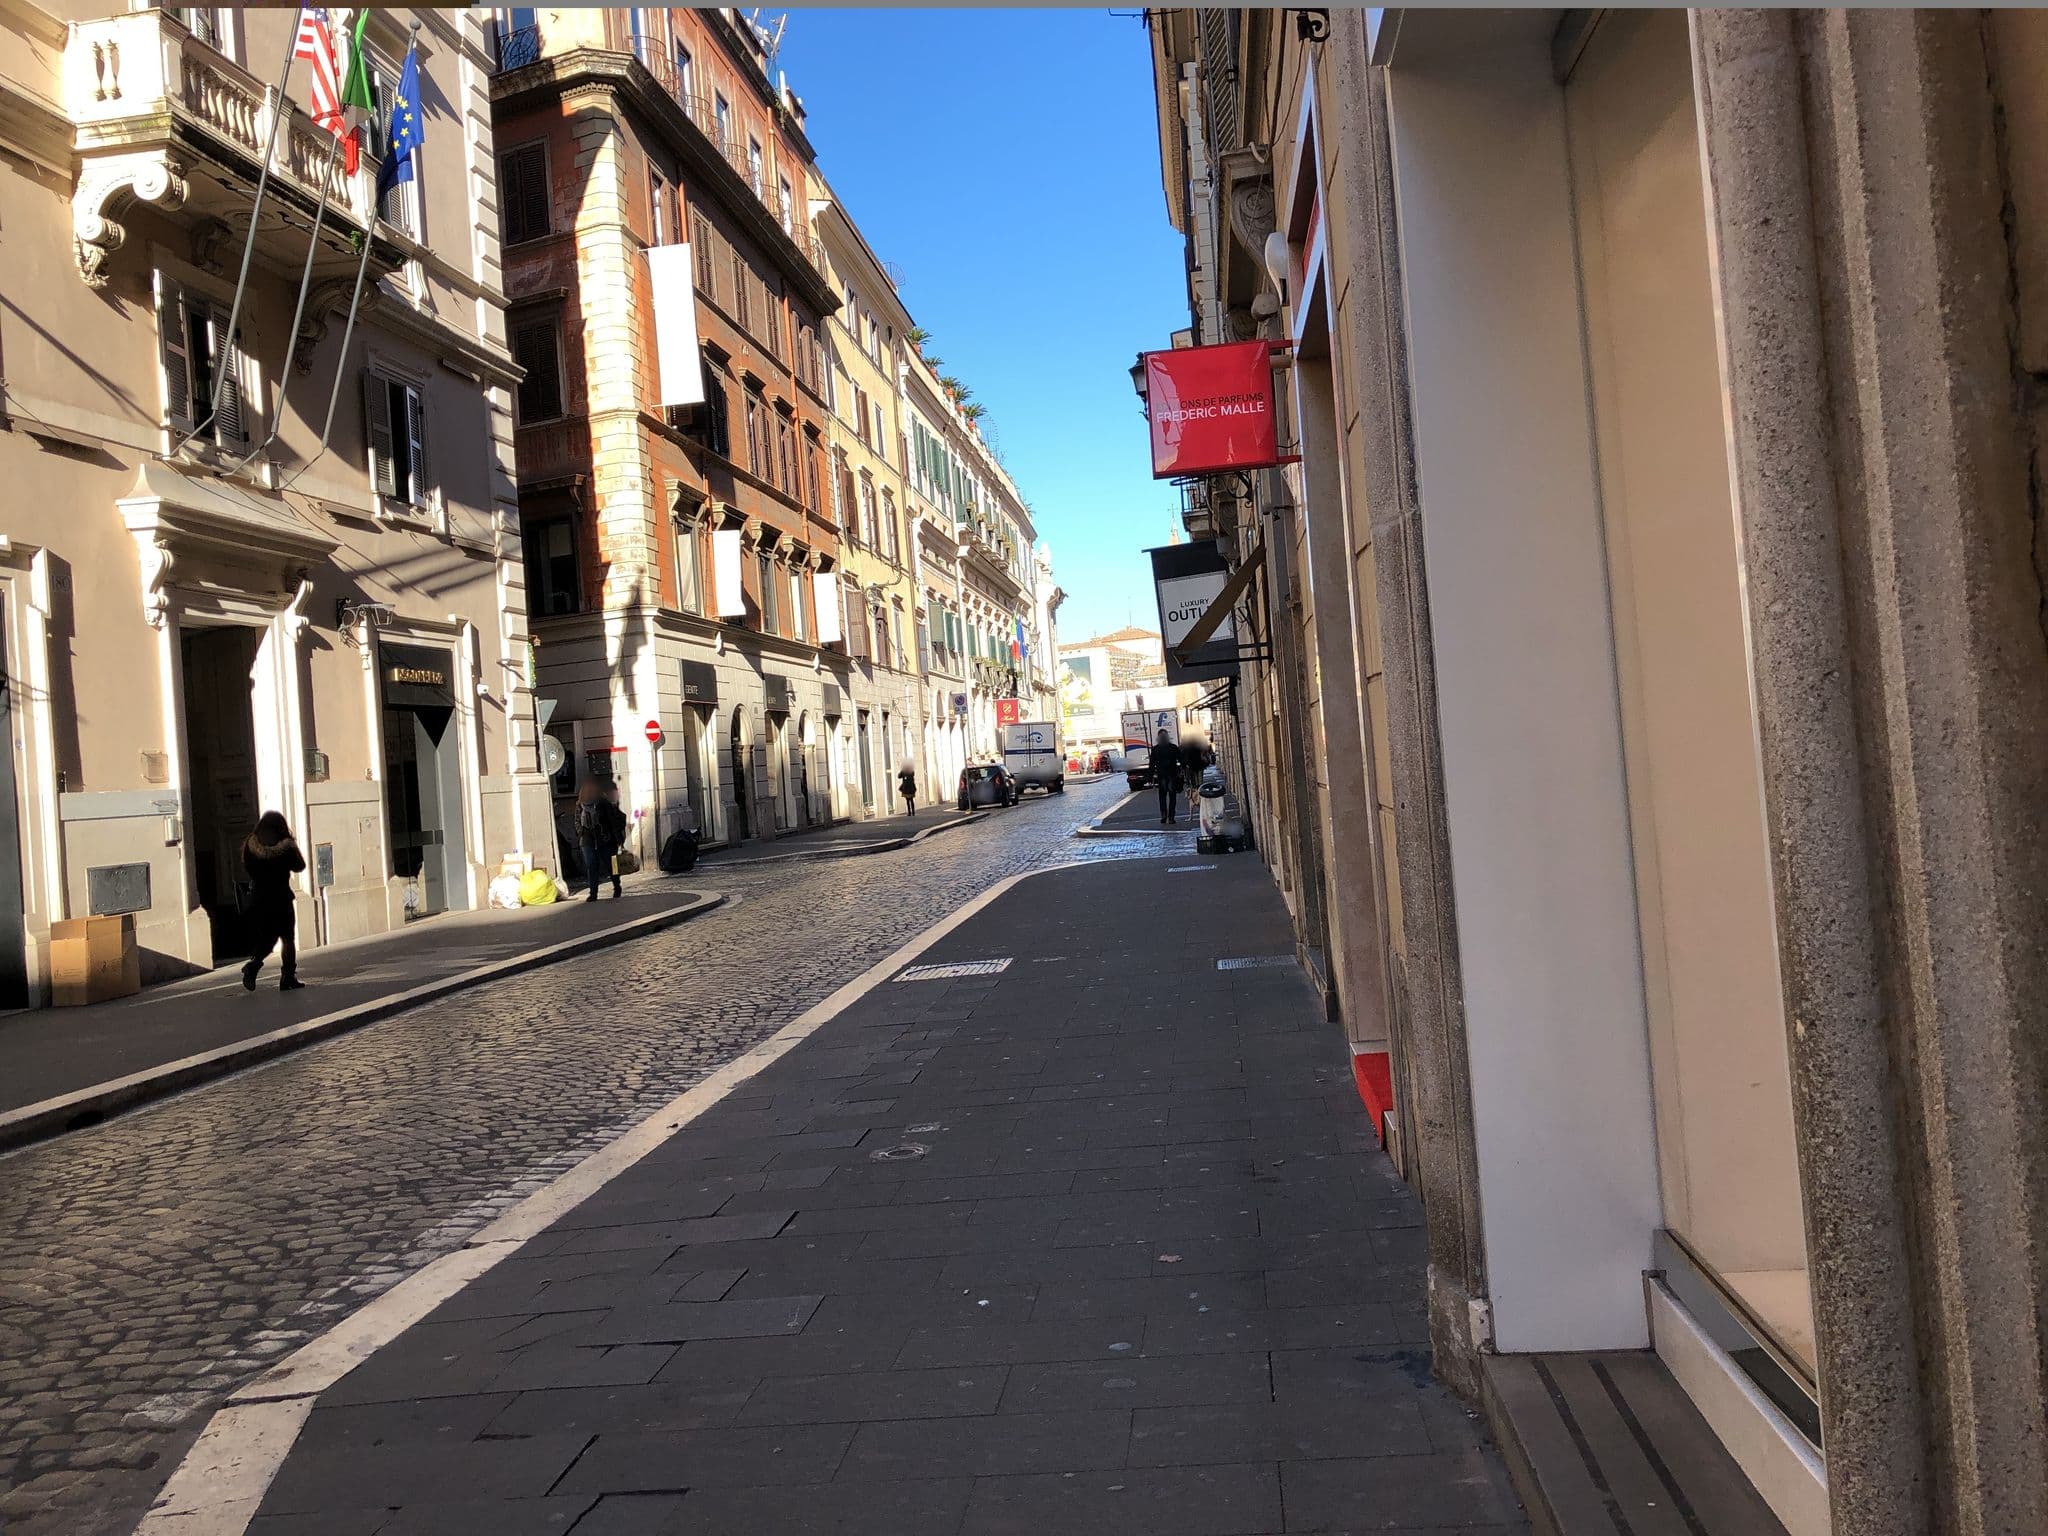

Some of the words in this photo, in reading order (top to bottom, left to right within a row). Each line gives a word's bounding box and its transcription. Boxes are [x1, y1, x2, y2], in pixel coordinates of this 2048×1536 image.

[1203, 397, 1216, 407] DE
[1219, 392, 1264, 405] PARFUMS
[1156, 406, 1217, 423] FREDERIC
[1220, 401, 1265, 417] MALLE
[1180, 598, 1209, 608] LUXURY
